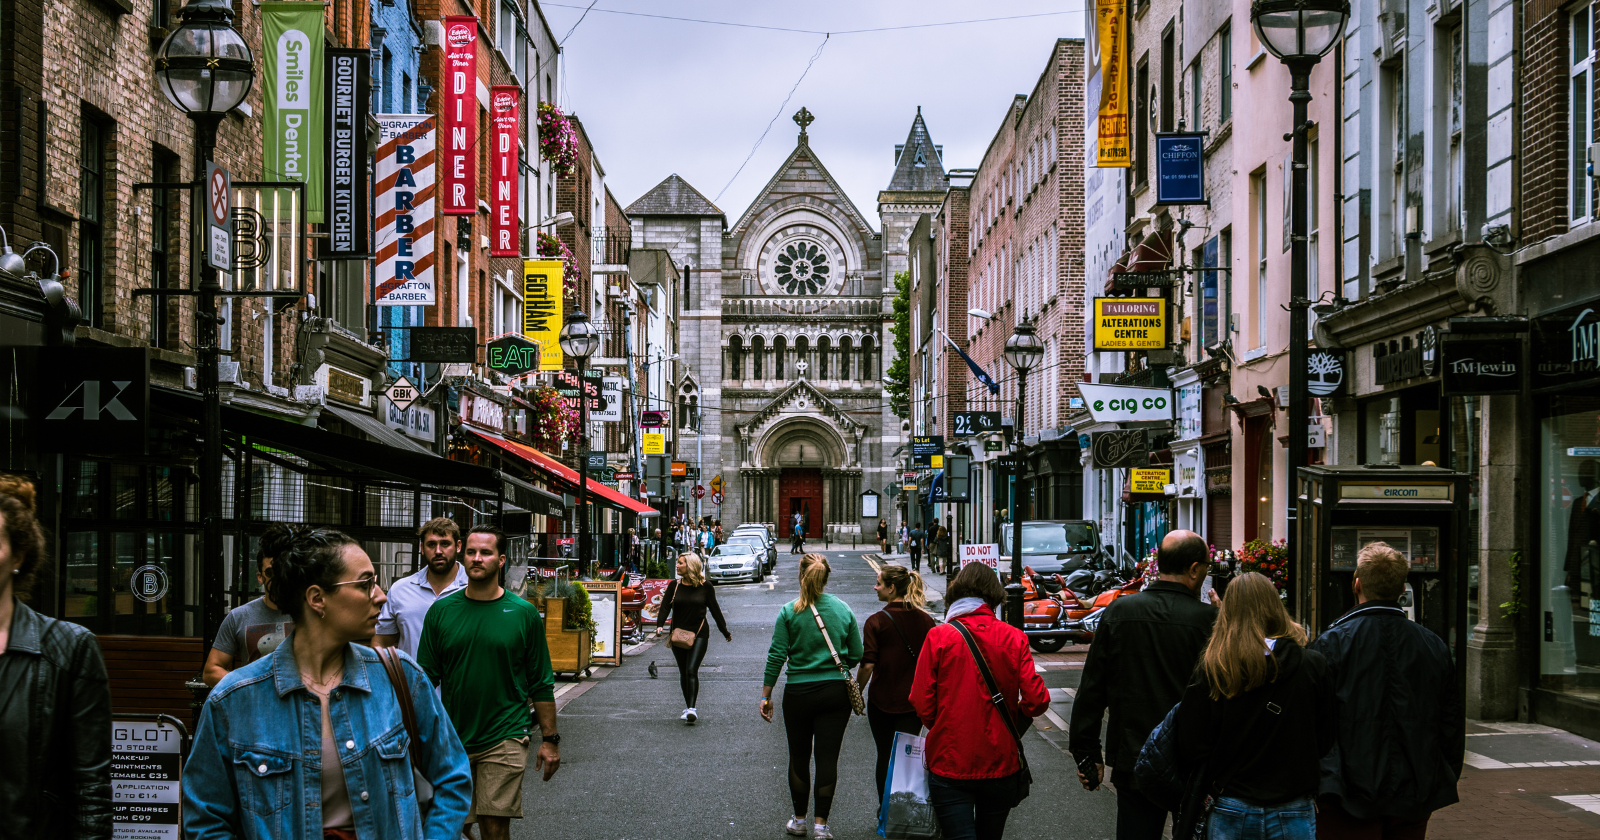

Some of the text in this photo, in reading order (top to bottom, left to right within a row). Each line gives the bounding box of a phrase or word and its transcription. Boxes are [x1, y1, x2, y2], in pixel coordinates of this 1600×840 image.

[285, 40, 303, 177] Smiles Dental
[389, 121, 432, 129] GRAFTON
[1100, 117, 1126, 135] CENTRE
[390, 131, 427, 140] BARBER
[453, 71, 466, 207] DINER
[335, 56, 352, 252] GOURMET BURGER KITCHEN
[1162, 151, 1198, 159] CHIFFON
[498, 132, 511, 250] DINER
[394, 145, 416, 280] BARBER
[388, 282, 431, 290] GRAFTON
[389, 293, 427, 301] BARBER
[526, 273, 557, 332] GOTHAM
[1107, 303, 1156, 314] TAILORING
[1102, 318, 1161, 328] ALTERATIONS
[416, 333, 471, 343] GRAFTON
[1114, 329, 1148, 339] CENTRE
[420, 345, 467, 355] BARBER
[490, 344, 535, 369] EAT
[579, 369, 602, 378] INES
[393, 389, 411, 398] GBK
[45, 380, 138, 420] AK
[1094, 399, 1104, 411] e
[1142, 397, 1166, 410] co
[966, 545, 991, 556] DO NOT
[143, 572, 158, 594] B
[115, 729, 173, 741] GLOT
